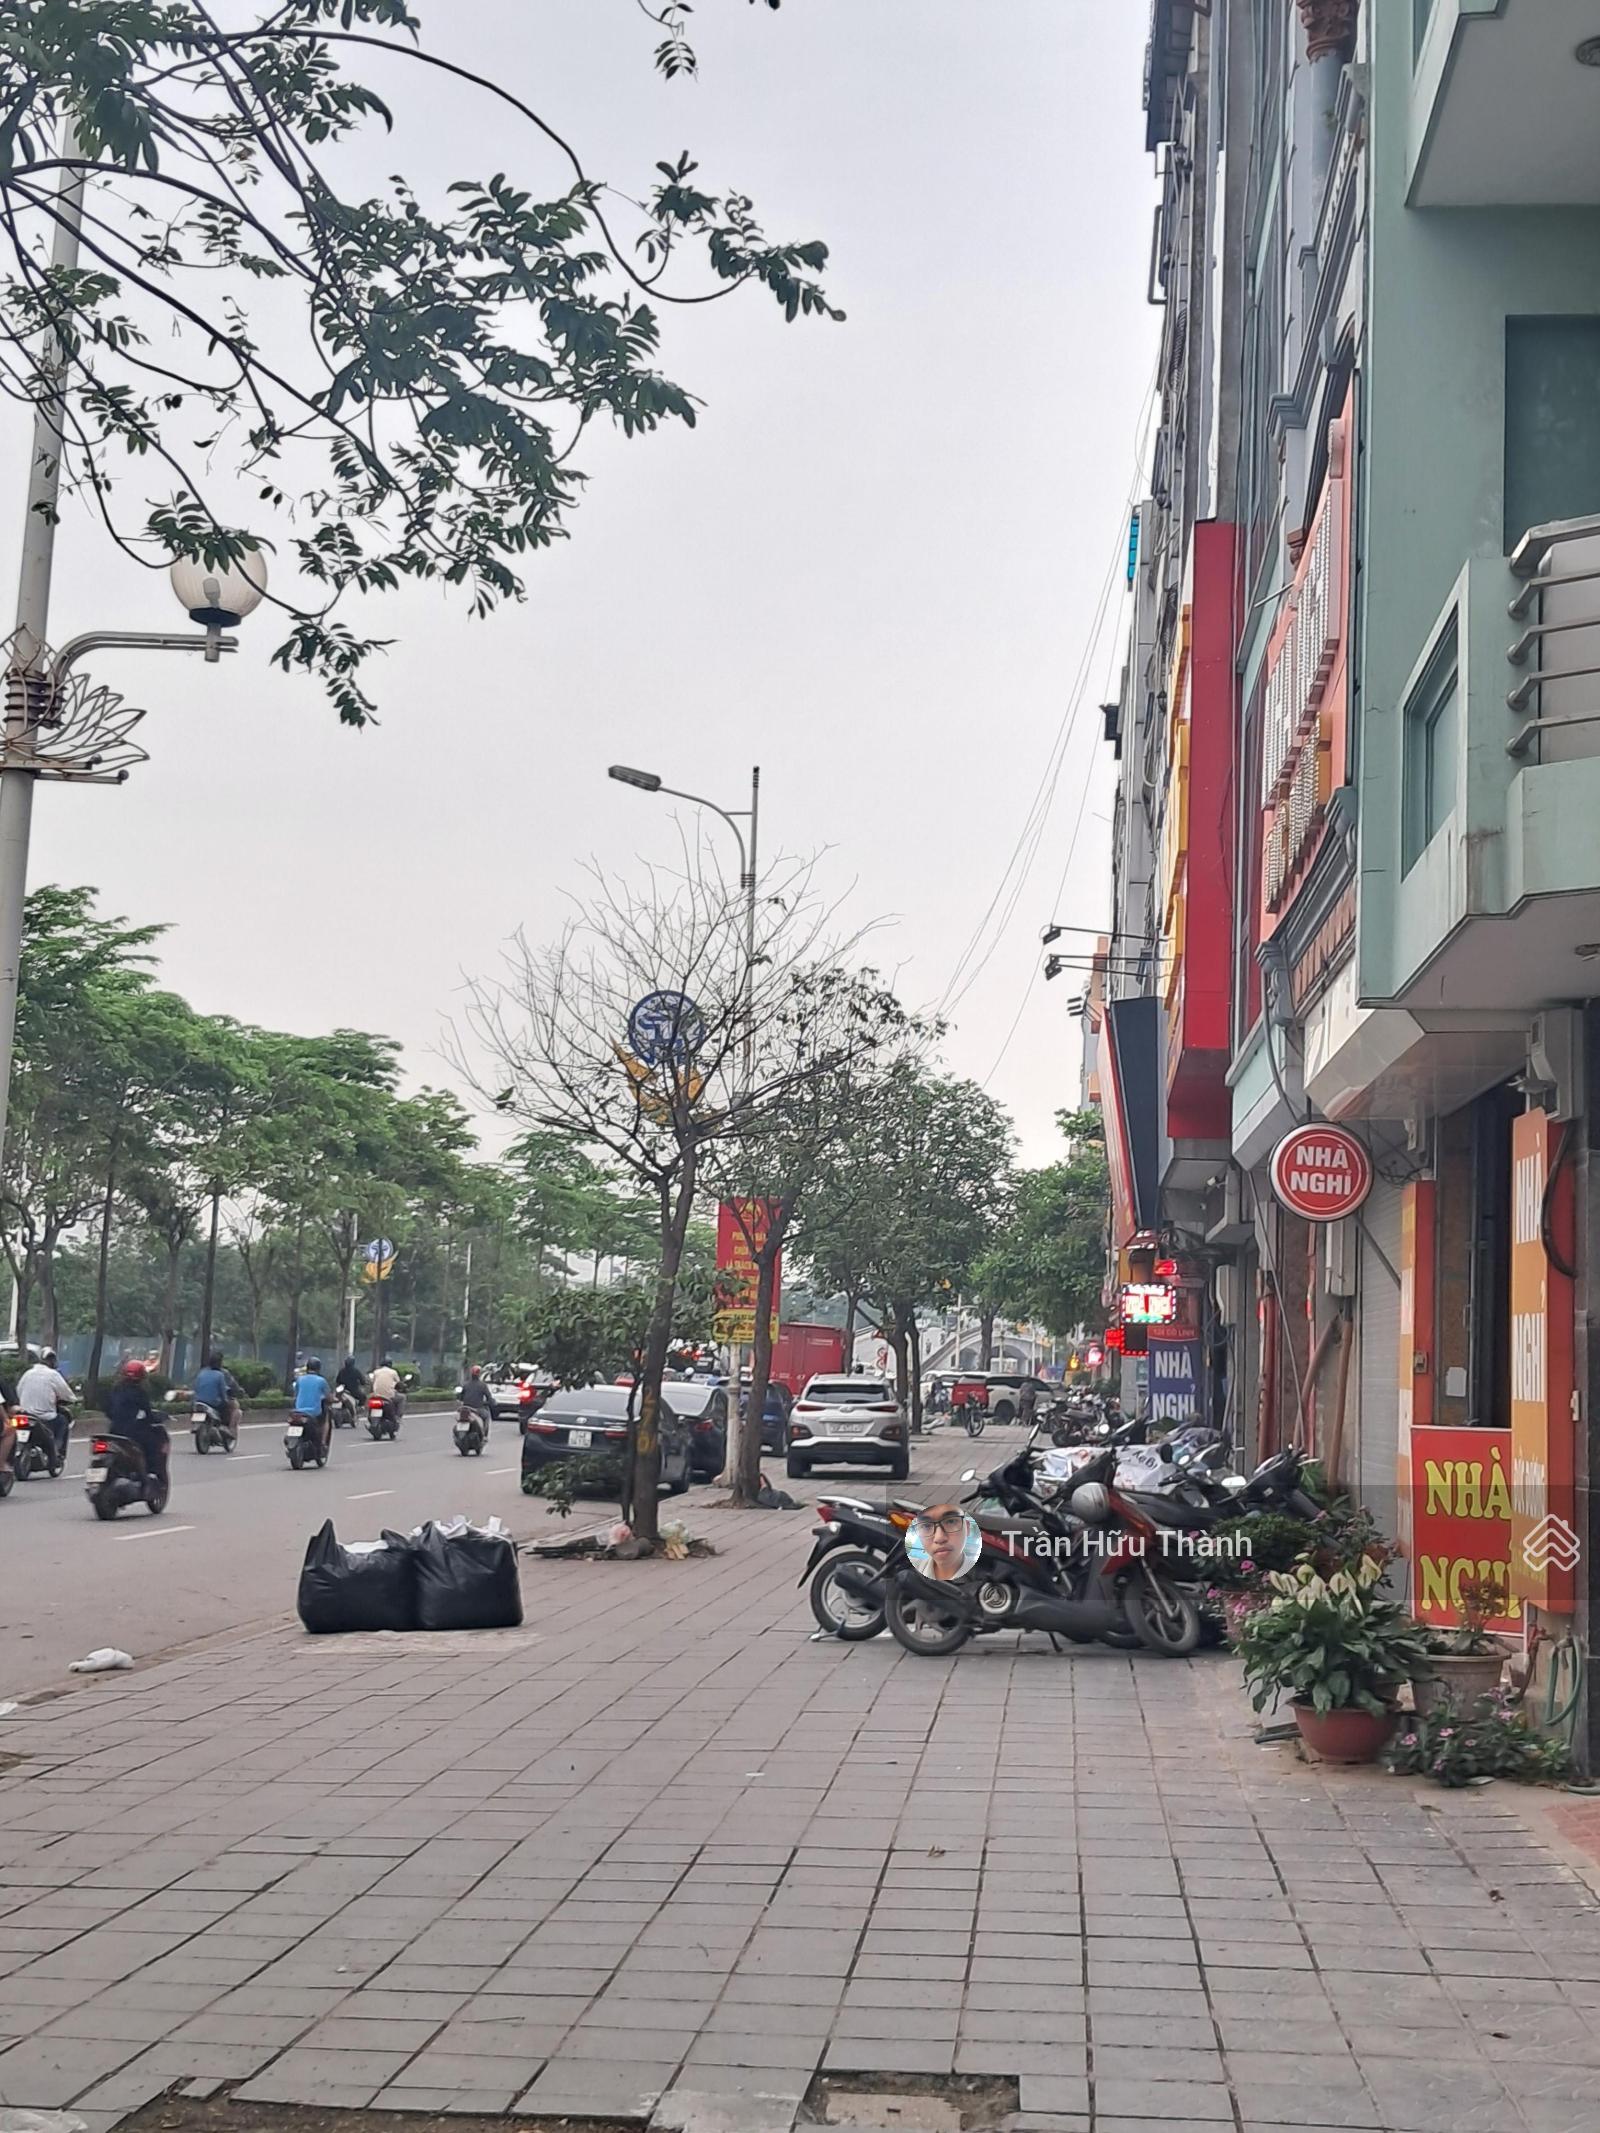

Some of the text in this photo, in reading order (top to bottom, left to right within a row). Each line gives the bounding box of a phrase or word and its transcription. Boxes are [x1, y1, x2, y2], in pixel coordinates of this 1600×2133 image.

[1296, 1144, 1348, 1169] NHÀ
[1290, 1170, 1352, 1196] NGHỈ
[1517, 1132, 1542, 1244] NHÀ
[1512, 1280, 1544, 1402] NGHỈ
[1155, 1345, 1193, 1378] NHÀ
[1152, 1384, 1196, 1421] NGHỈ
[1424, 1446, 1512, 1520] NHÀ
